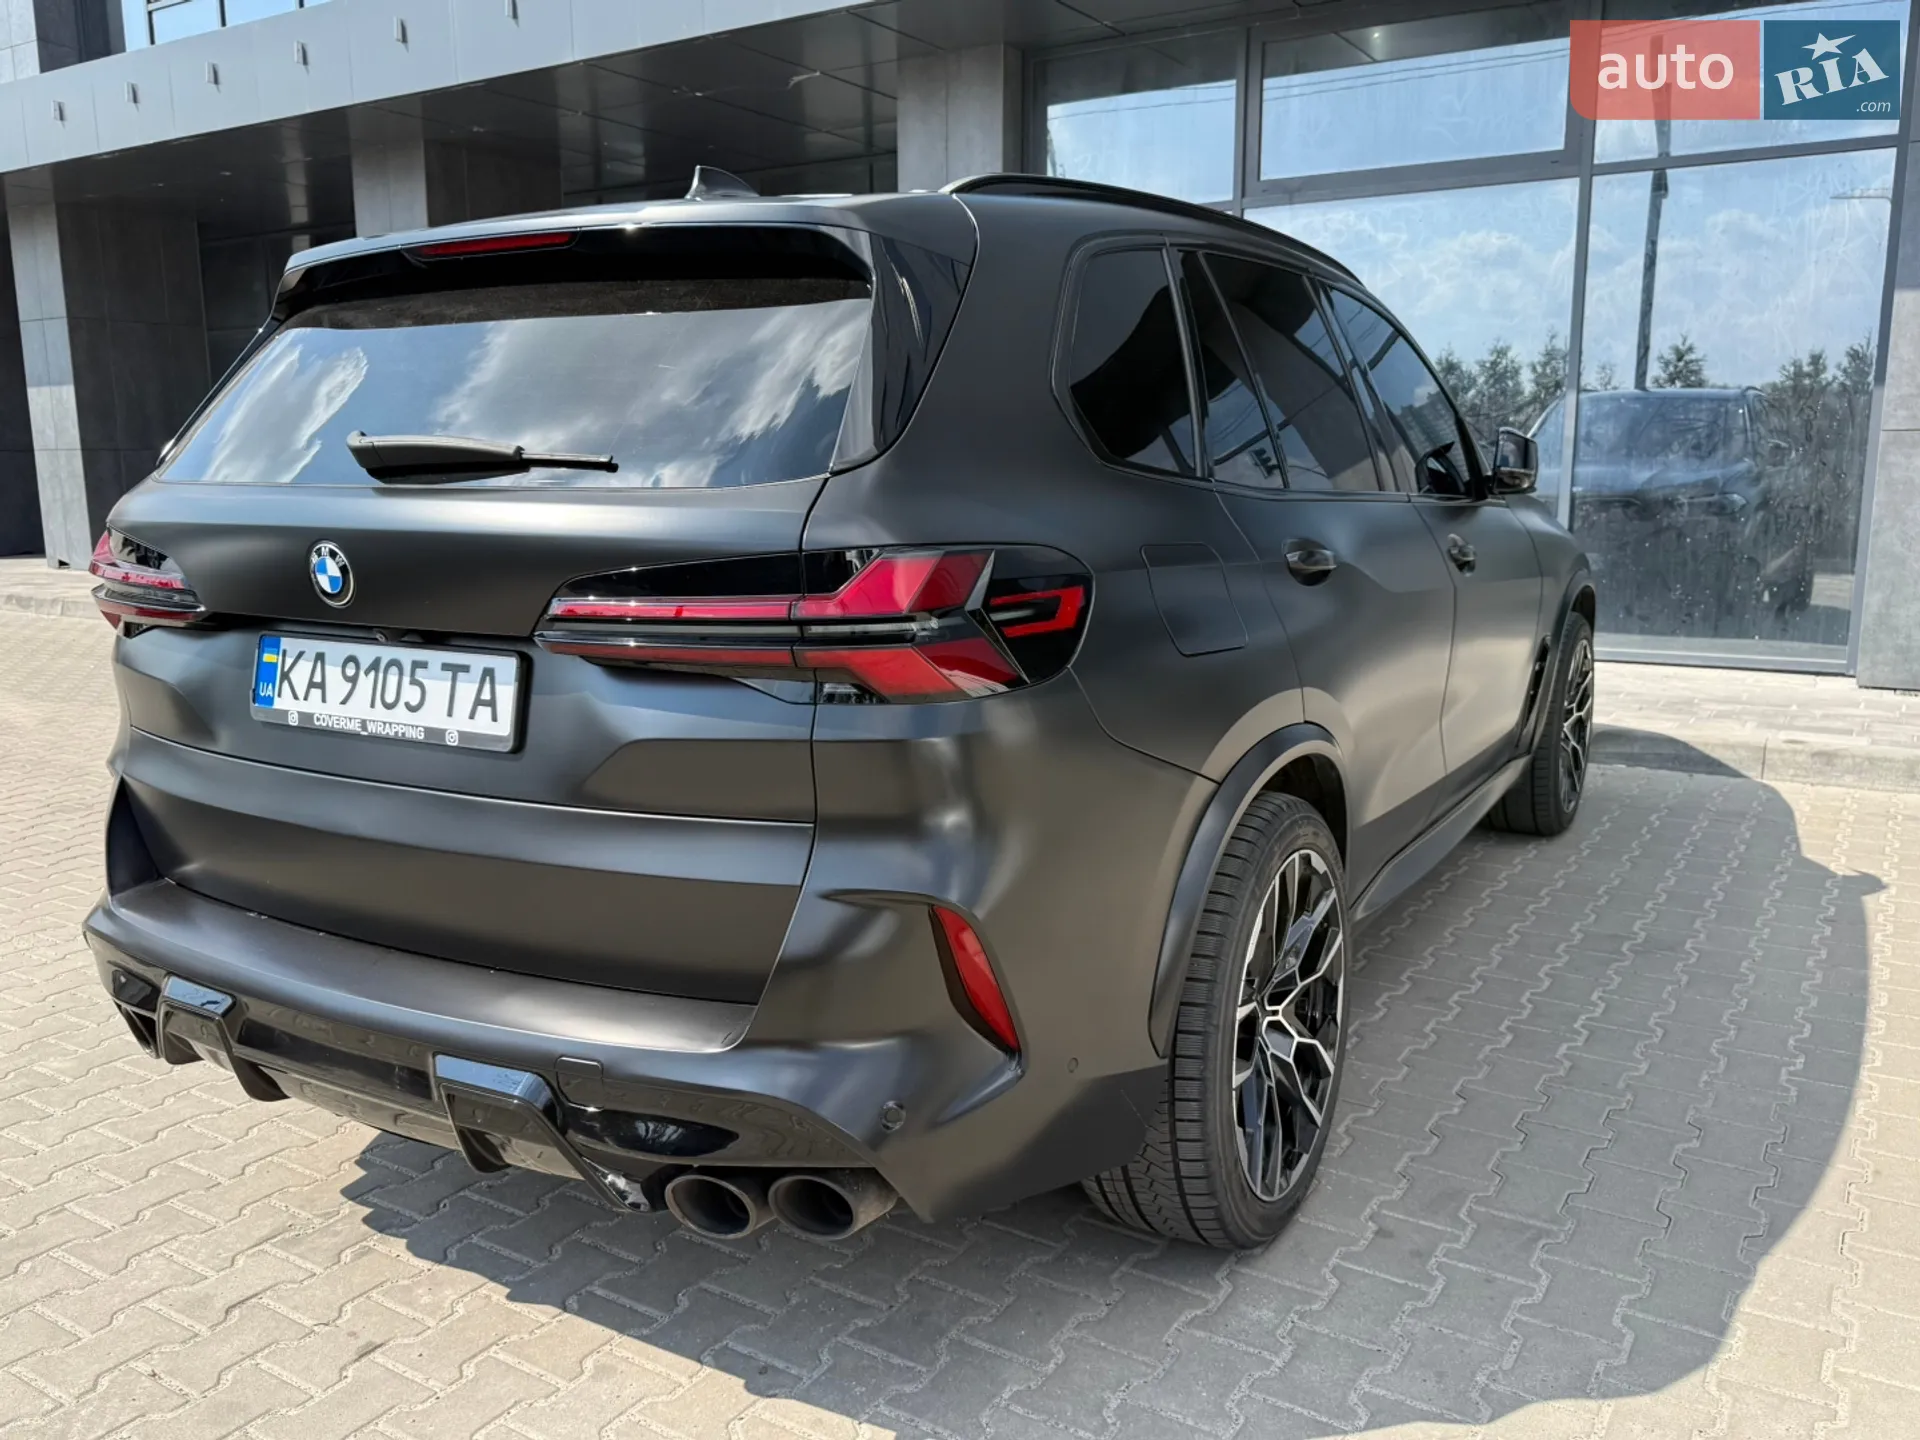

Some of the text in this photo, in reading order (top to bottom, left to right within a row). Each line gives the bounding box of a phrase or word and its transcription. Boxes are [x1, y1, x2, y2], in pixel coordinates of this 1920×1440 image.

[311, 546, 346, 567] BMW
[259, 681, 273, 697] UA
[277, 648, 499, 722] KA 9105 TA
